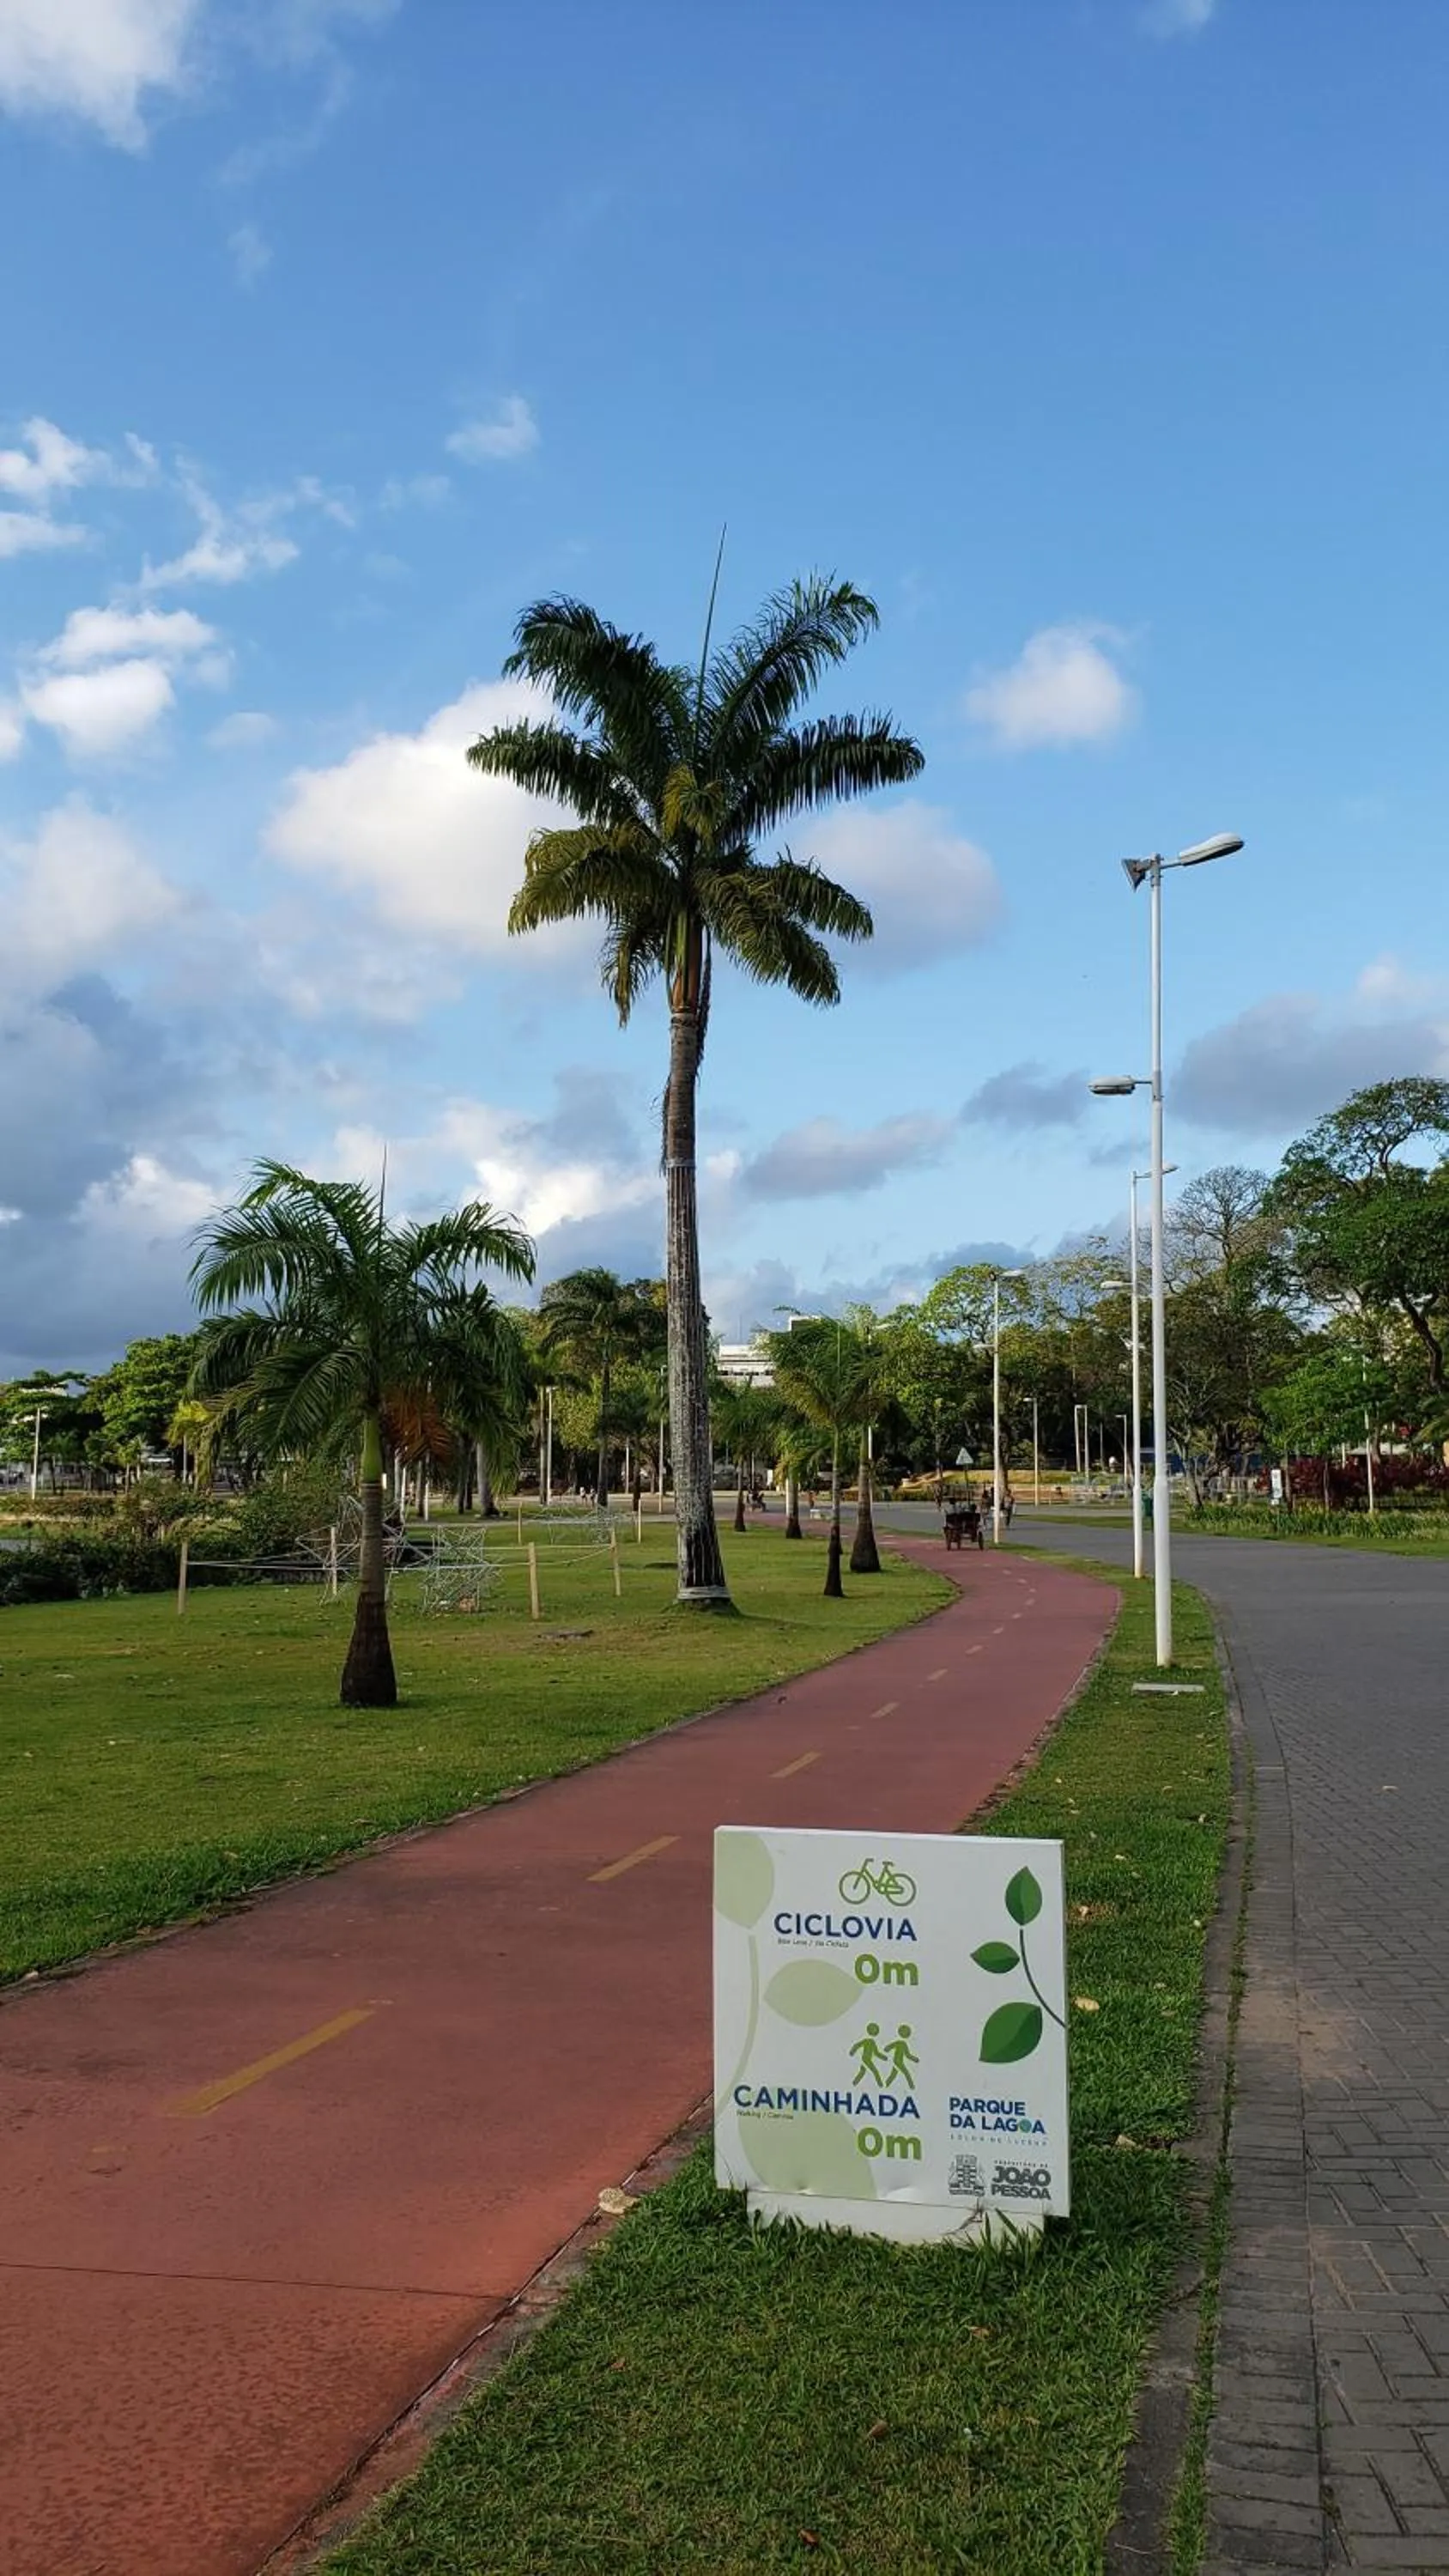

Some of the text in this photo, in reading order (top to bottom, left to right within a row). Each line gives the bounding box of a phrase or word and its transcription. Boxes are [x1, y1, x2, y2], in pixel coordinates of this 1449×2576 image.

[774, 1912, 918, 1941] CICLOVIA
[855, 1953, 919, 1986] 0m
[734, 2085, 920, 2118] CAMINHADA
[949, 2097, 1026, 2116] PARQUE
[950, 2114, 1046, 2134] DA LAGOA
[858, 2126, 922, 2160] 0m
[991, 2184, 1052, 2200] PESSOA
